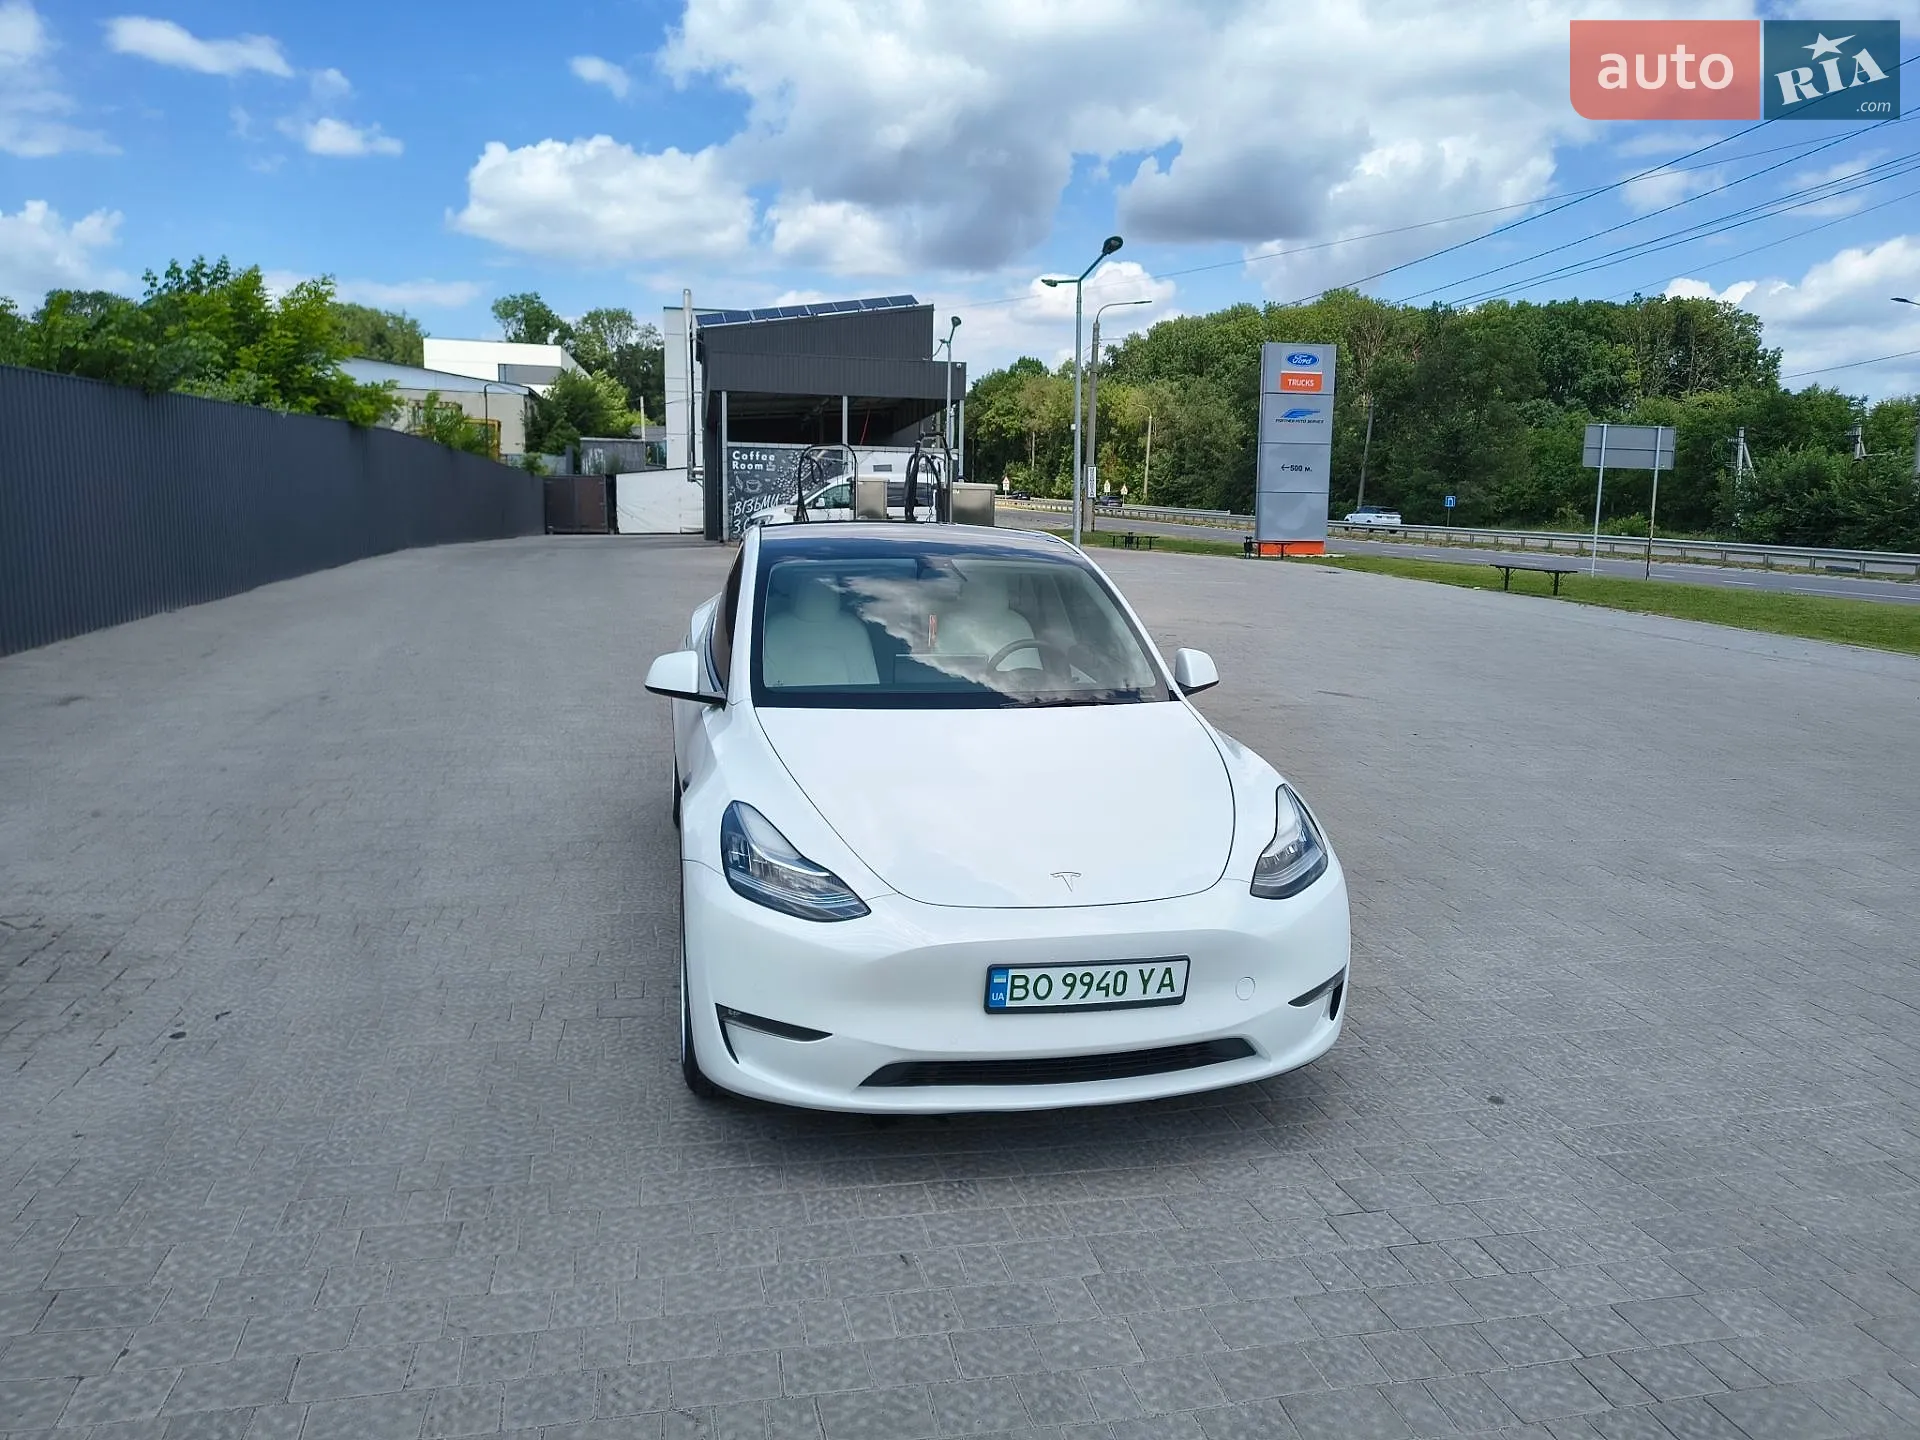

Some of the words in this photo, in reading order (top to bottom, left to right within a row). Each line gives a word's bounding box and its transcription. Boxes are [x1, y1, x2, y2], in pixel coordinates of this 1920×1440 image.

[1292, 354, 1312, 364] Ford
[1287, 378, 1315, 387] TRUCKS
[732, 451, 775, 461] Coffee
[732, 461, 763, 470] Room
[1290, 464, 1303, 472] 500
[733, 493, 781, 516] ВІЗЬМИ
[1009, 974, 1053, 1001] BO
[1061, 970, 1128, 1000] 9940
[1138, 967, 1176, 995] YA
[991, 992, 1005, 1001] UA
